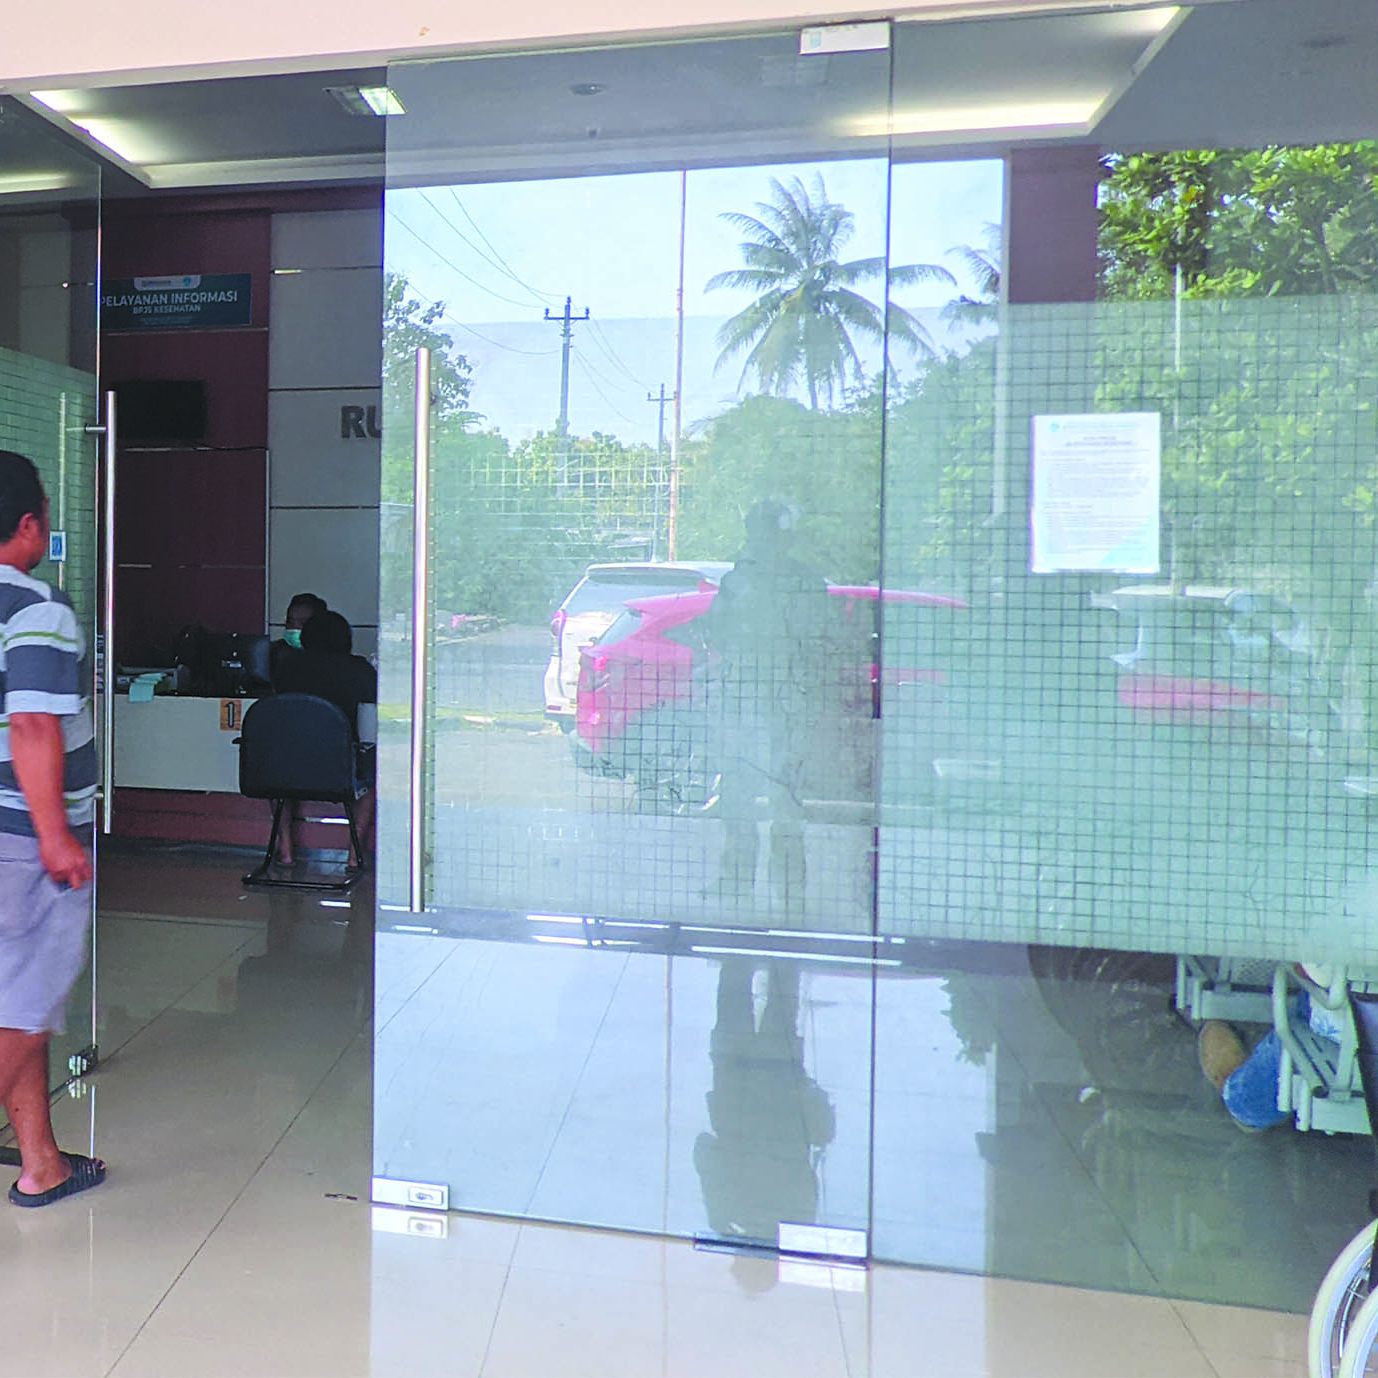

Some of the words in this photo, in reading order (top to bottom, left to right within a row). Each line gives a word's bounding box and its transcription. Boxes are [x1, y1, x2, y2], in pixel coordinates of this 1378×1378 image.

[171, 290, 238, 304] INFORMASI
[133, 305, 152, 315] BPJS
[153, 303, 201, 314] KESEHATAN
[224, 702, 235, 728] 1
